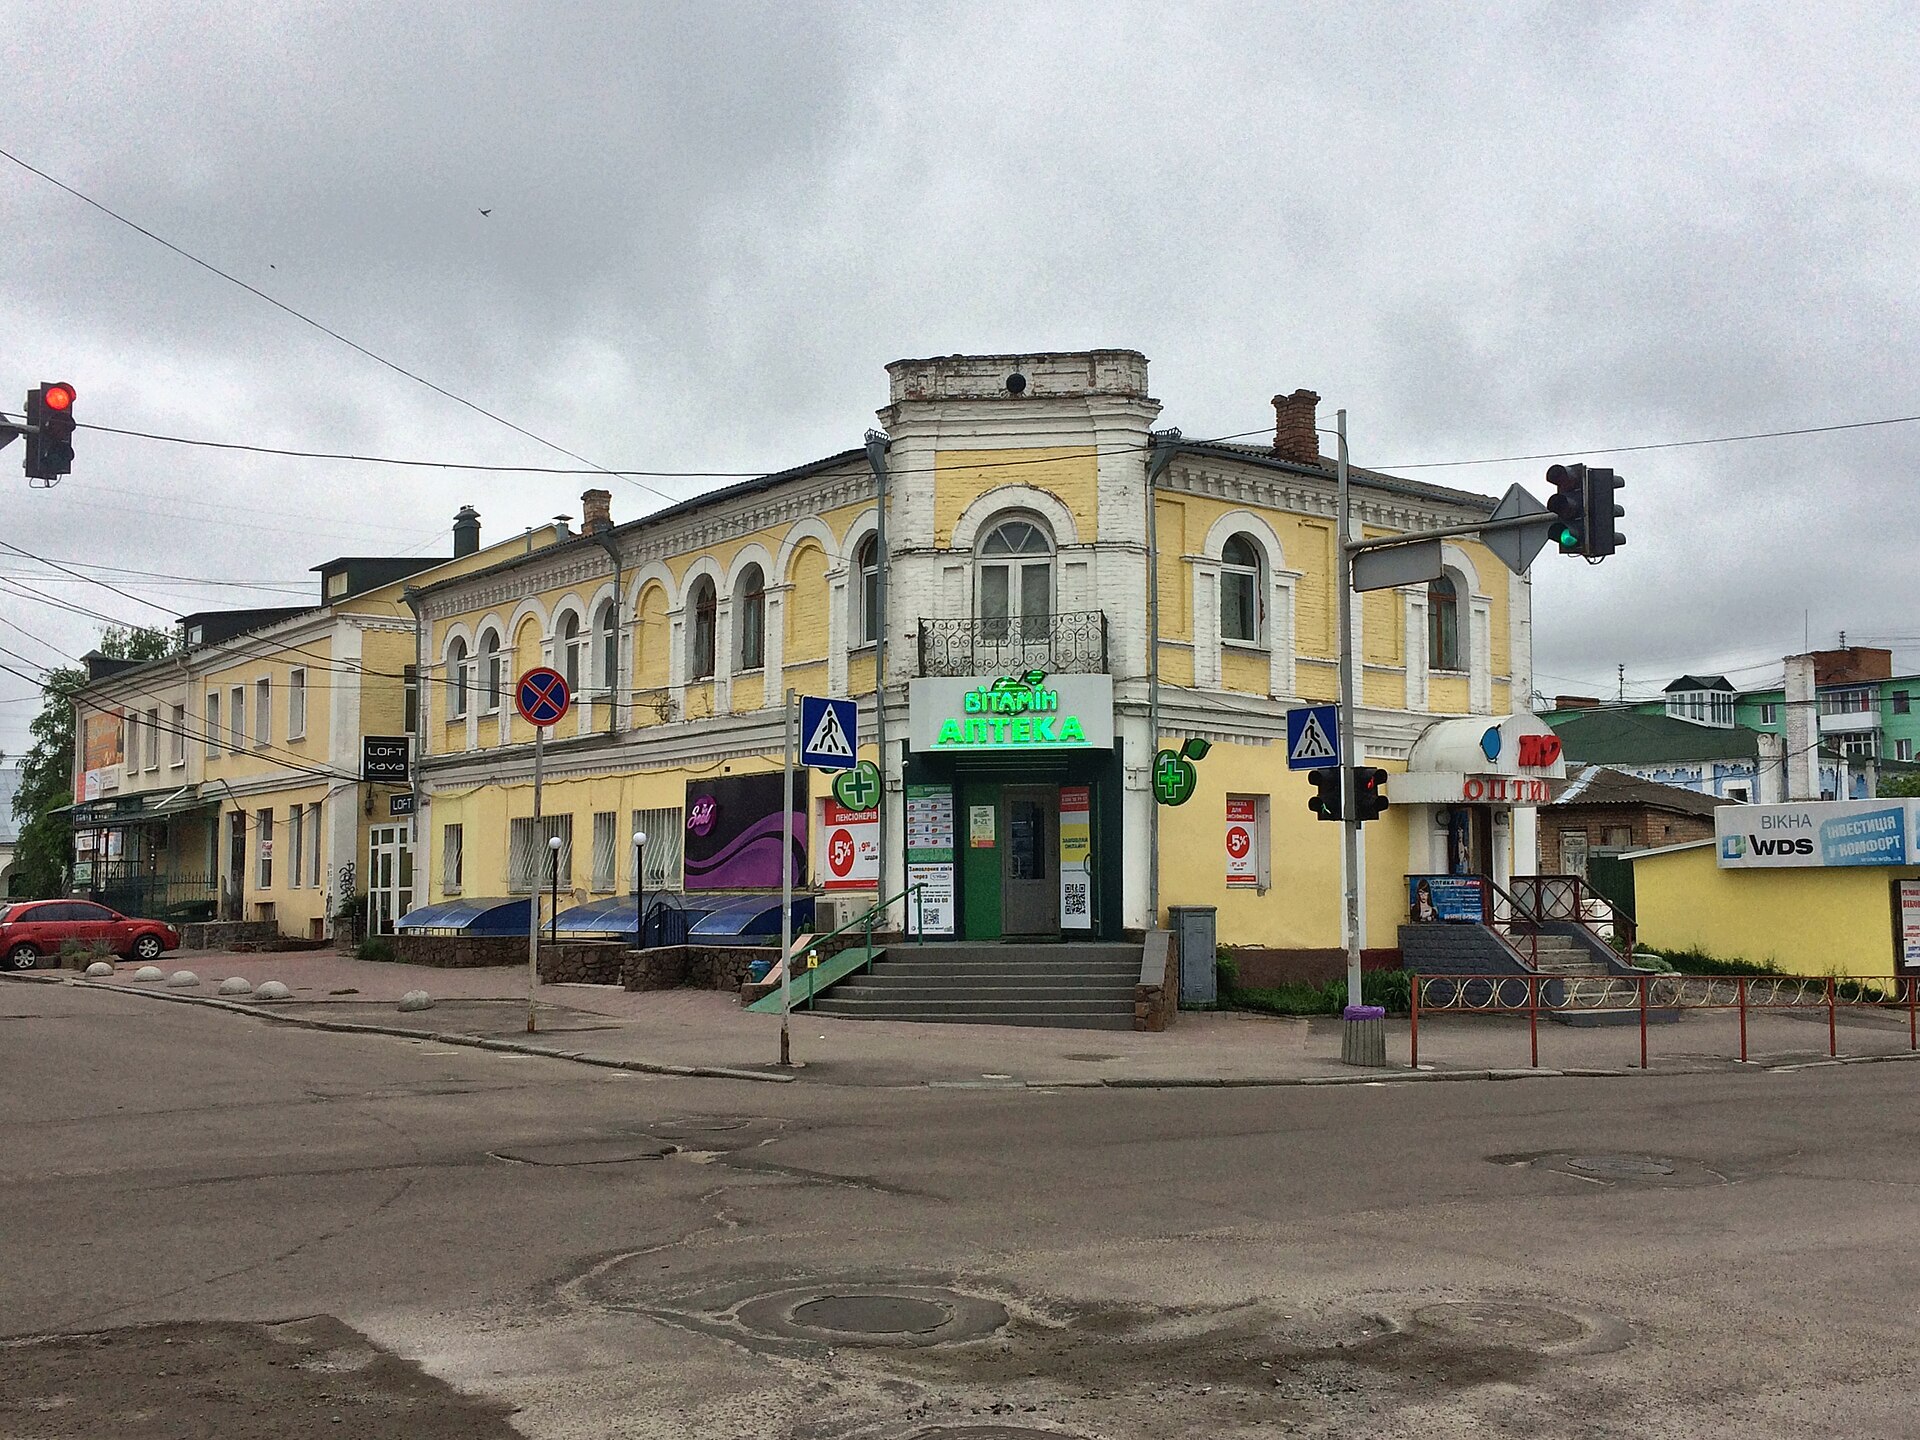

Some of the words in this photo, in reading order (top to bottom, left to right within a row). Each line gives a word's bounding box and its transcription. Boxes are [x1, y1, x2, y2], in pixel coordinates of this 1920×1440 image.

[964, 685, 1058, 713] ВІТАМІН
[937, 716, 1086, 744] АПТЕКА
[367, 747, 405, 756] LOFT
[367, 761, 405, 771] kava
[392, 797, 413, 810] LOFT
[835, 811, 877, 822] ПЕНСІОНЕРІВ
[1761, 814, 1813, 830] ВІКНА
[1827, 815, 1897, 838] ІНВЕСТИЦІЯ
[1749, 834, 1814, 856] WDS
[1839, 835, 1900, 857] КОМФОРТ
